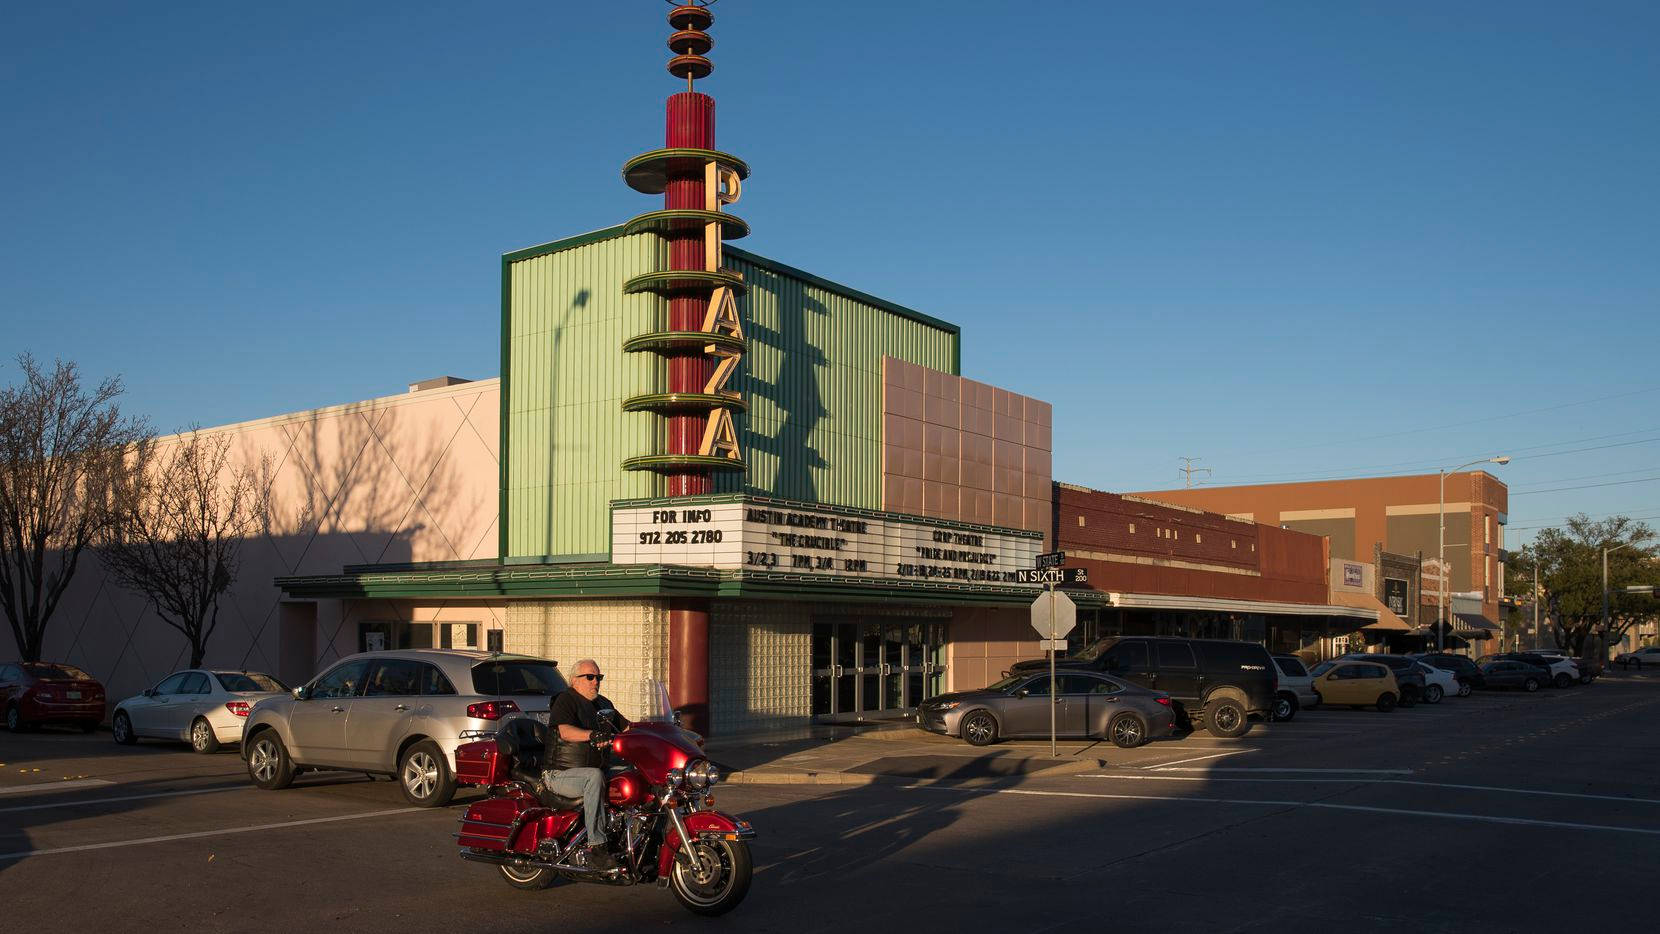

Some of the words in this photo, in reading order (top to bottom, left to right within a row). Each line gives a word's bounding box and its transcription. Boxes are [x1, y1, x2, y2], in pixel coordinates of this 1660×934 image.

[698, 160, 743, 461] PLAZA
[653, 510, 677, 524] FOR
[682, 509, 712, 523] INFO
[746, 508, 784, 525] AUSTIN
[786, 512, 828, 531] ACADEMY
[640, 531, 661, 544] 972
[665, 531, 687, 544] 205
[691, 530, 722, 544] 2780
[953, 532, 984, 547] THEATRE
[1018, 570, 1027, 581] N
[1030, 570, 1064, 581] SIXTH
